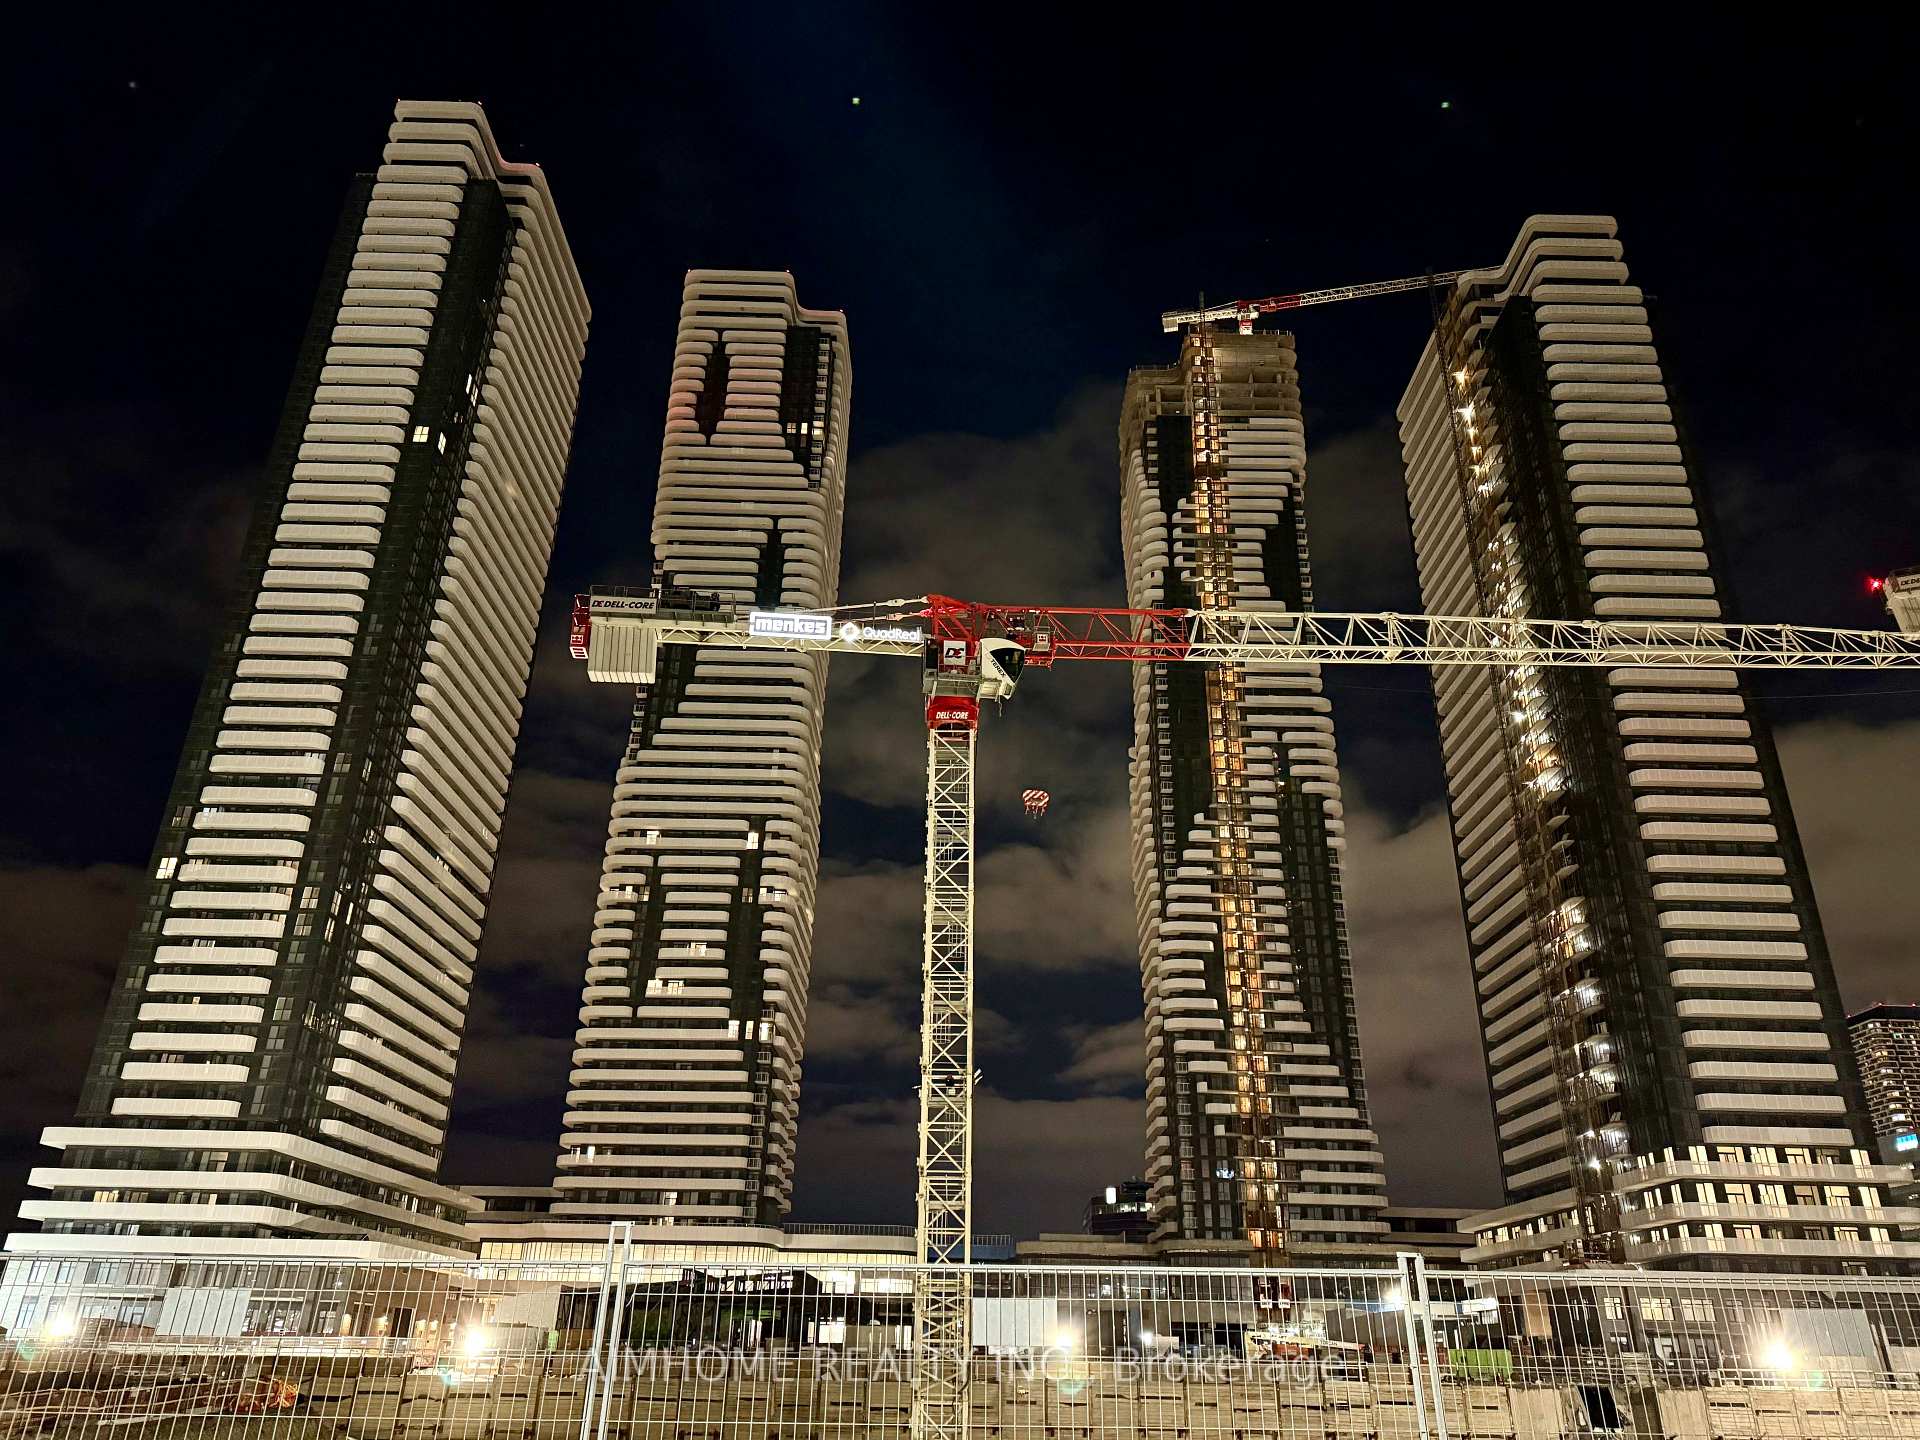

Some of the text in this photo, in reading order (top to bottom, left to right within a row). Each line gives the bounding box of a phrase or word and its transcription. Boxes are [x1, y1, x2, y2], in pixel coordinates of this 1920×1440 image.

[604, 600, 655, 609] DELL-CORE
[755, 616, 826, 634] menkes
[863, 626, 920, 641] QuadReal
